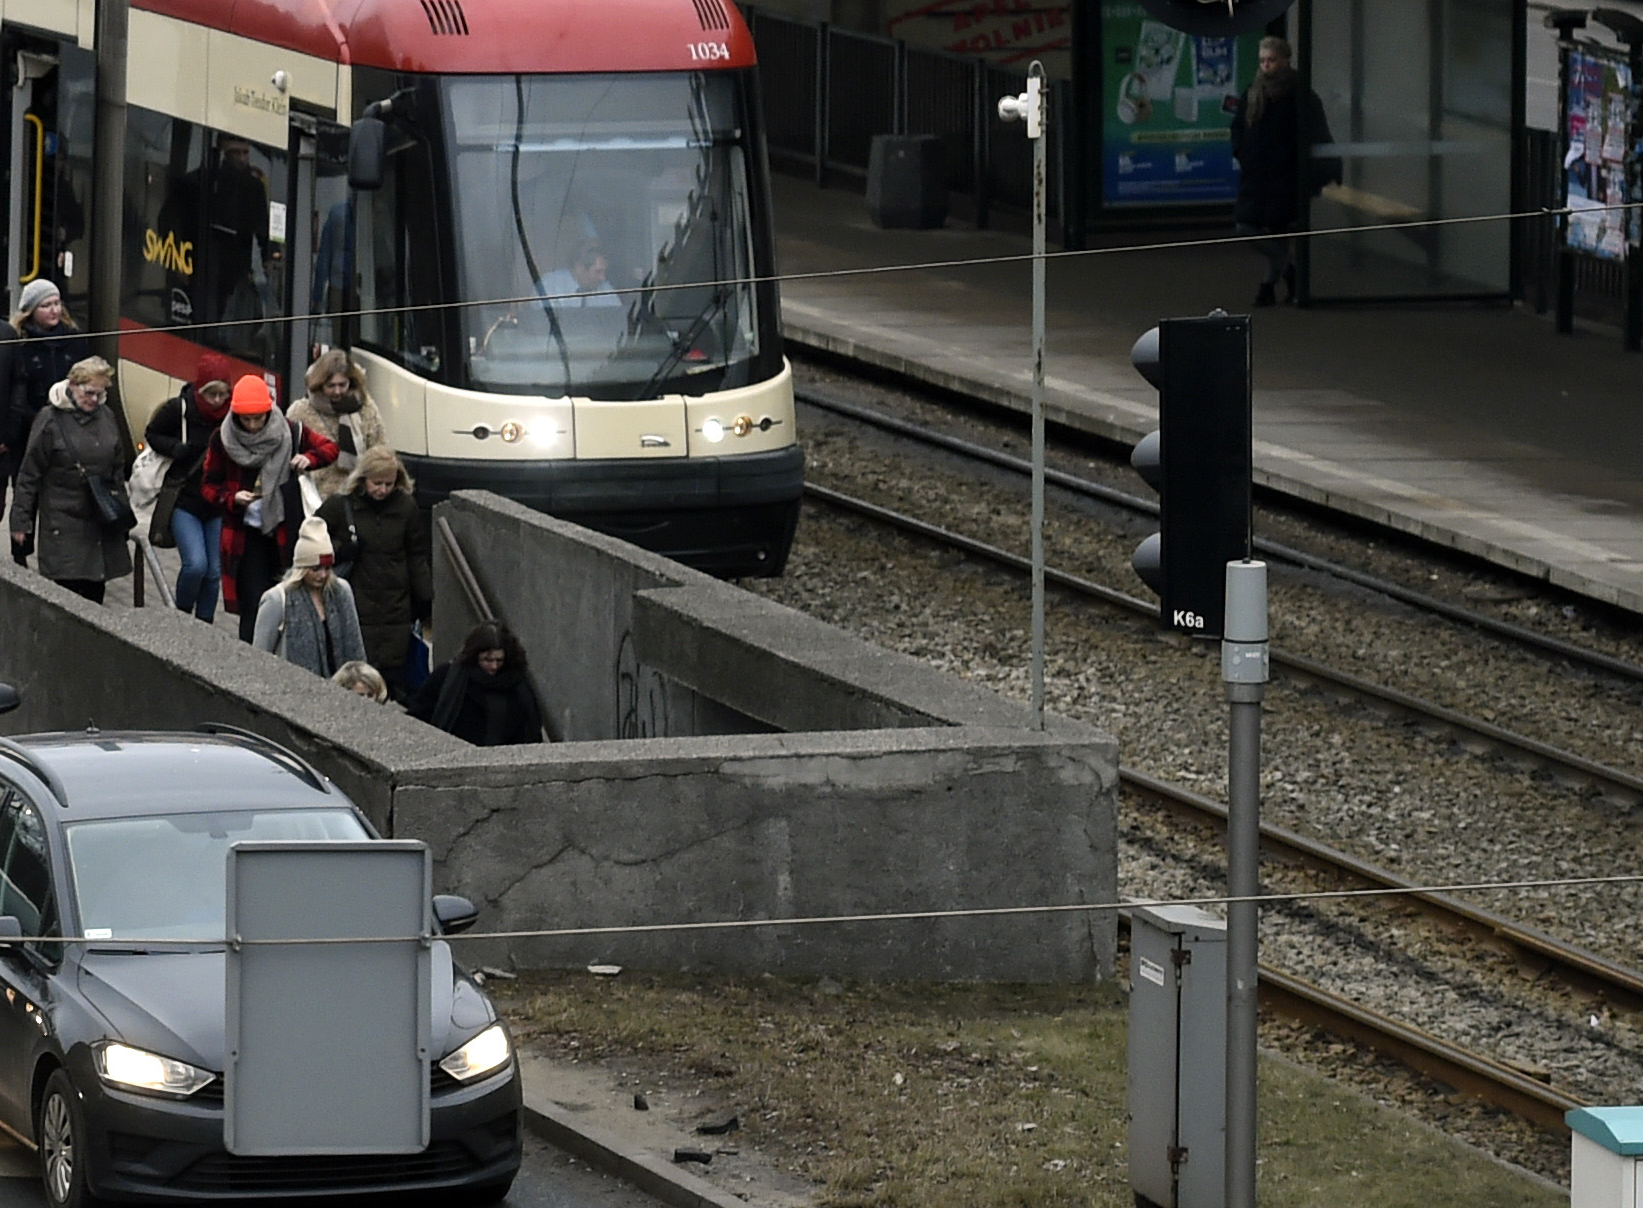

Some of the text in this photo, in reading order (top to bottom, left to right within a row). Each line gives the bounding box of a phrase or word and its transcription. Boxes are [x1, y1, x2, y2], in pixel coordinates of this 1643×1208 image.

[687, 42, 730, 60] 1034
[143, 228, 194, 276] SWING
[1173, 610, 1204, 629] K6a
